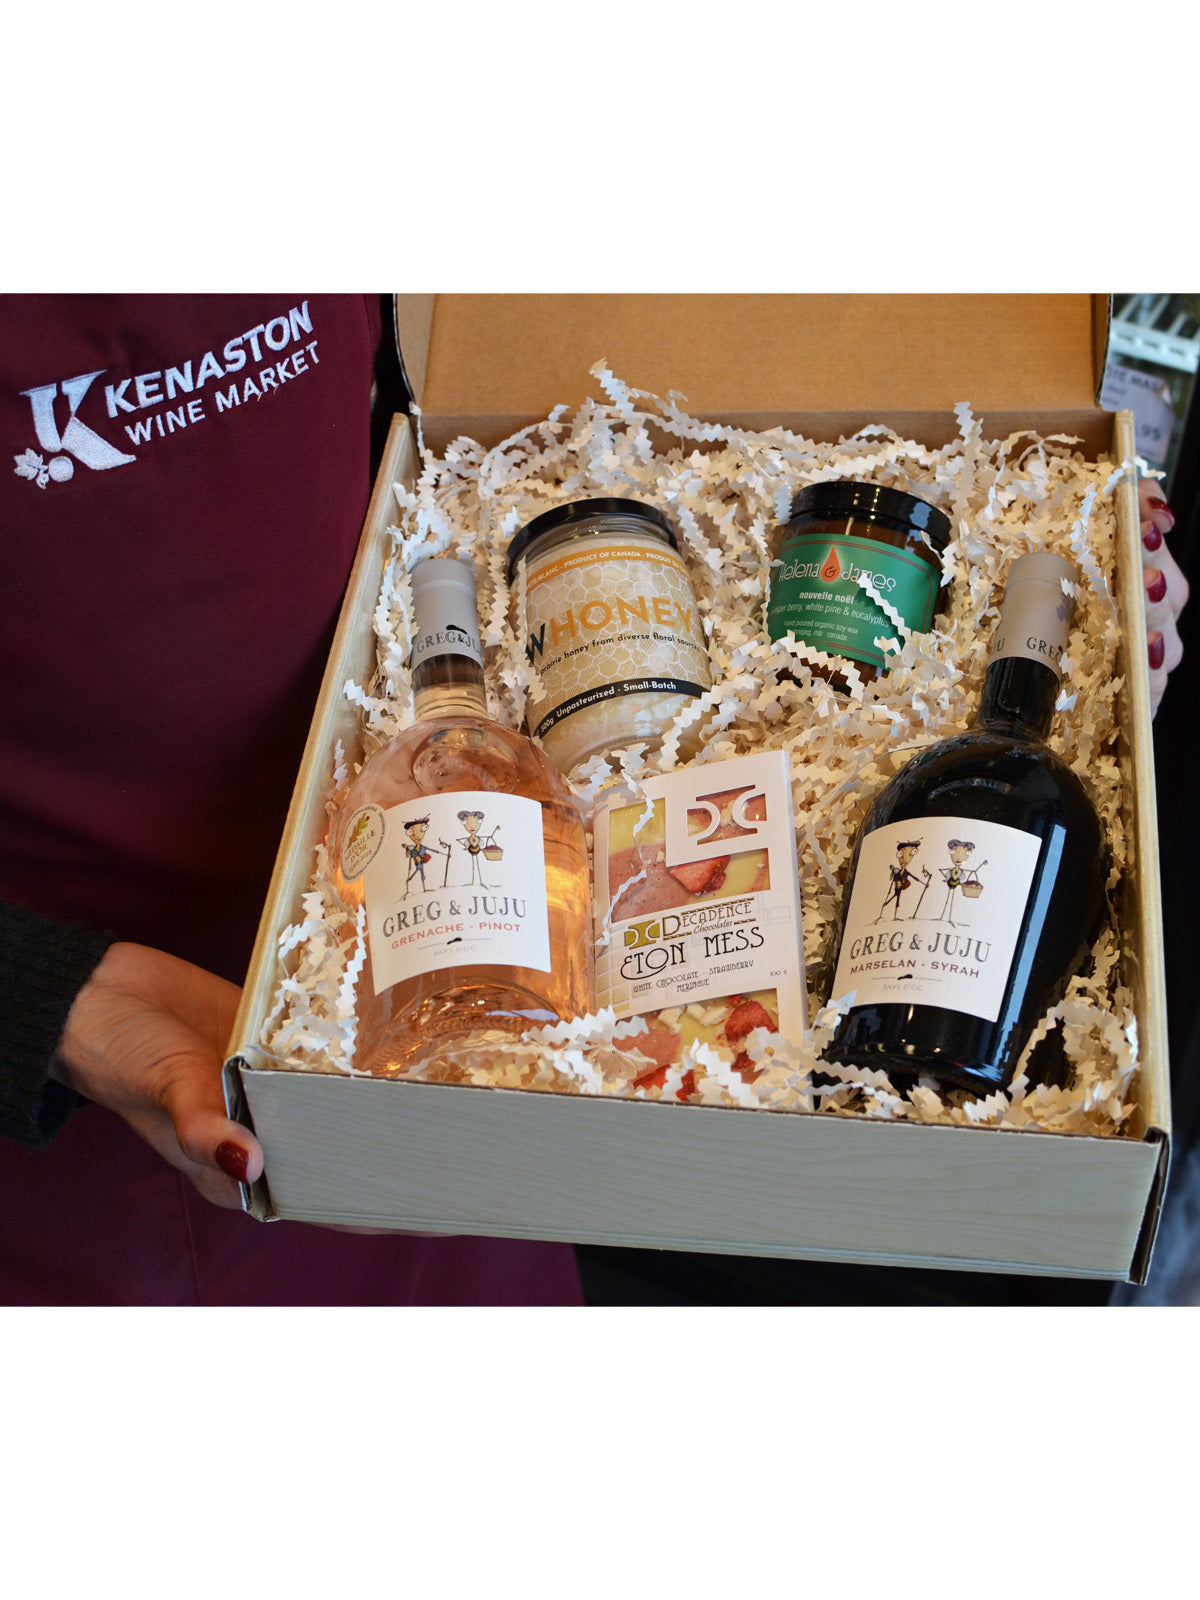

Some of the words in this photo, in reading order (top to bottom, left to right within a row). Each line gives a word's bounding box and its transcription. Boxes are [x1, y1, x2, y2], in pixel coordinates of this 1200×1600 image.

[104, 301, 314, 418] KENASTON
[124, 399, 206, 446] WINE
[215, 341, 321, 413] MARKET
[564, 554, 597, 568] PRODUCT
[779, 559, 821, 583] Helena
[799, 591, 833, 601] nouvelle
[835, 594, 855, 605] noël
[788, 603, 804, 613] berry,
[806, 602, 824, 612] white
[825, 605, 842, 615] pine
[843, 607, 850, 616] &
[851, 608, 889, 628] eucalyptus
[795, 620, 814, 628] poured
[814, 620, 835, 631] organic
[836, 623, 847, 633] soy
[827, 631, 847, 641] canada
[539, 656, 562, 676] prairie
[564, 644, 589, 660] honey
[592, 638, 614, 648] from
[617, 633, 650, 642] diverse
[653, 631, 675, 642] floral
[556, 687, 615, 718] Unpasteurized
[623, 681, 677, 691] Small-Batch
[382, 901, 441, 938] GREG
[449, 900, 462, 916] &
[468, 895, 527, 918] JUJU
[662, 901, 752, 938] DECADENCE
[693, 919, 734, 935] Chocolates
[391, 923, 464, 950] GRENACHE
[479, 922, 521, 932] PINOT
[850, 932, 904, 960] GREG
[909, 933, 922, 950] &
[928, 932, 992, 962] JUJU
[620, 941, 687, 981] ETON
[704, 926, 765, 958] MESS
[633, 981, 652, 993] WHITE
[656, 970, 699, 988] CHOCOLATE
[709, 960, 754, 976] STRAWBERRY
[850, 959, 917, 975] MARSELAN
[930, 961, 980, 979] SYRAH
[677, 978, 710, 993] MERINGUE
